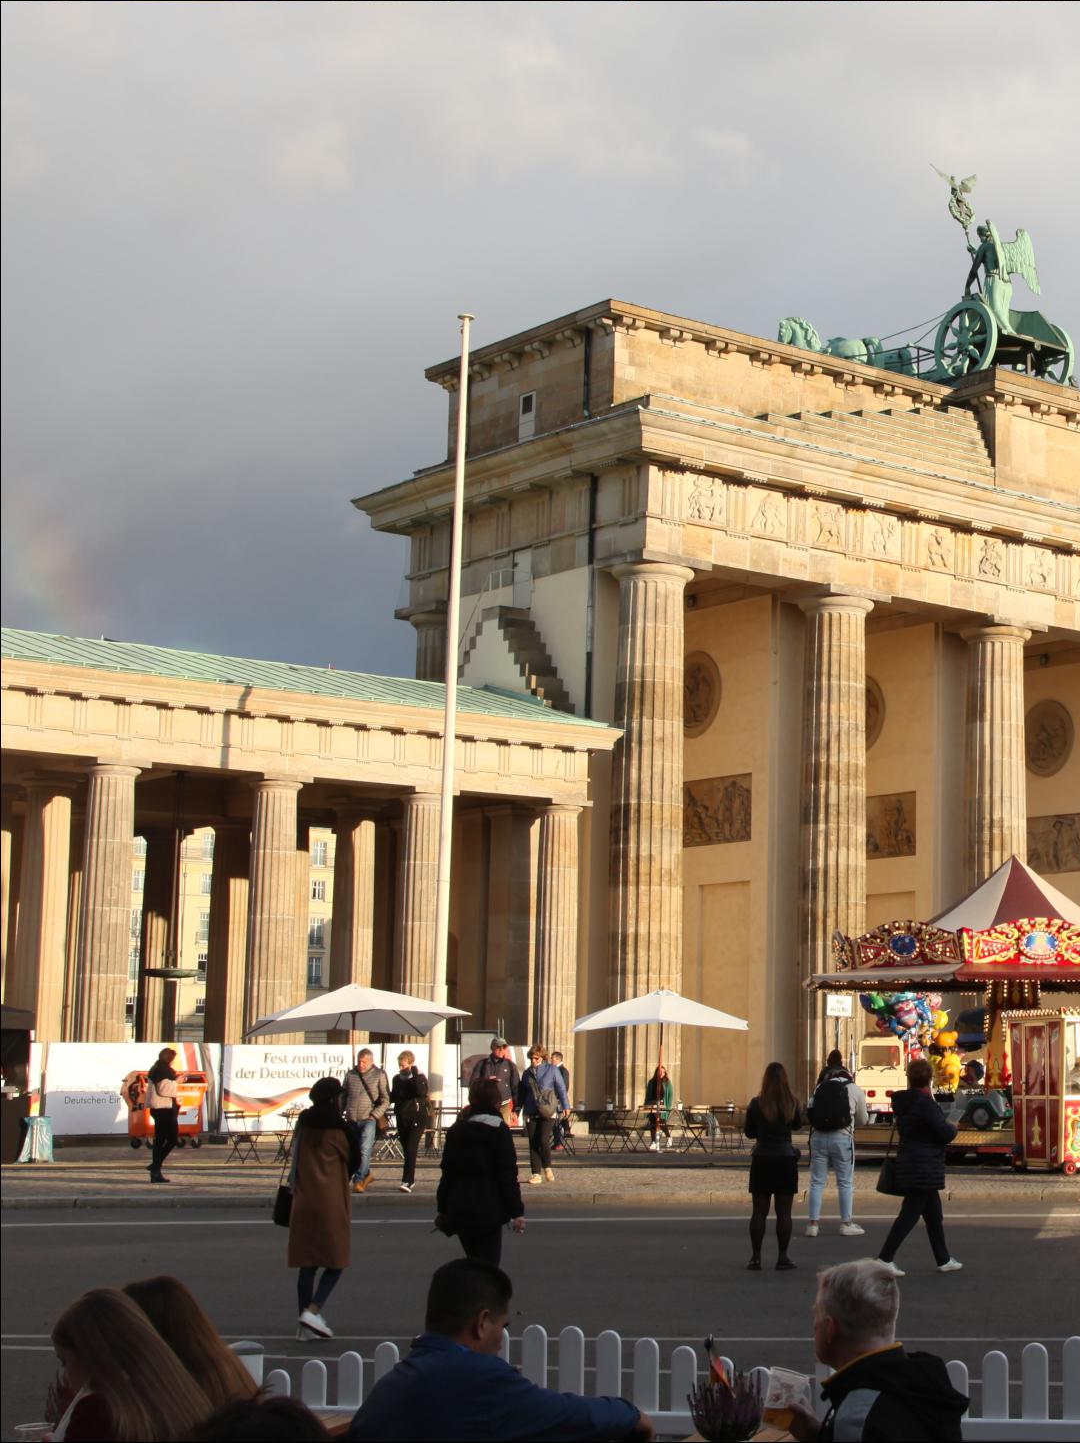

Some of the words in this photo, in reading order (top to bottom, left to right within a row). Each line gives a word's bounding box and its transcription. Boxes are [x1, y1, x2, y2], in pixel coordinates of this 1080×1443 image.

[264, 1052, 290, 1065] Fest
[292, 1055, 318, 1065] zum
[322, 1052, 344, 1067] Tag
[235, 1067, 256, 1079] der
[259, 1065, 326, 1079] Deutschen
[64, 1095, 107, 1105] Deutschen
